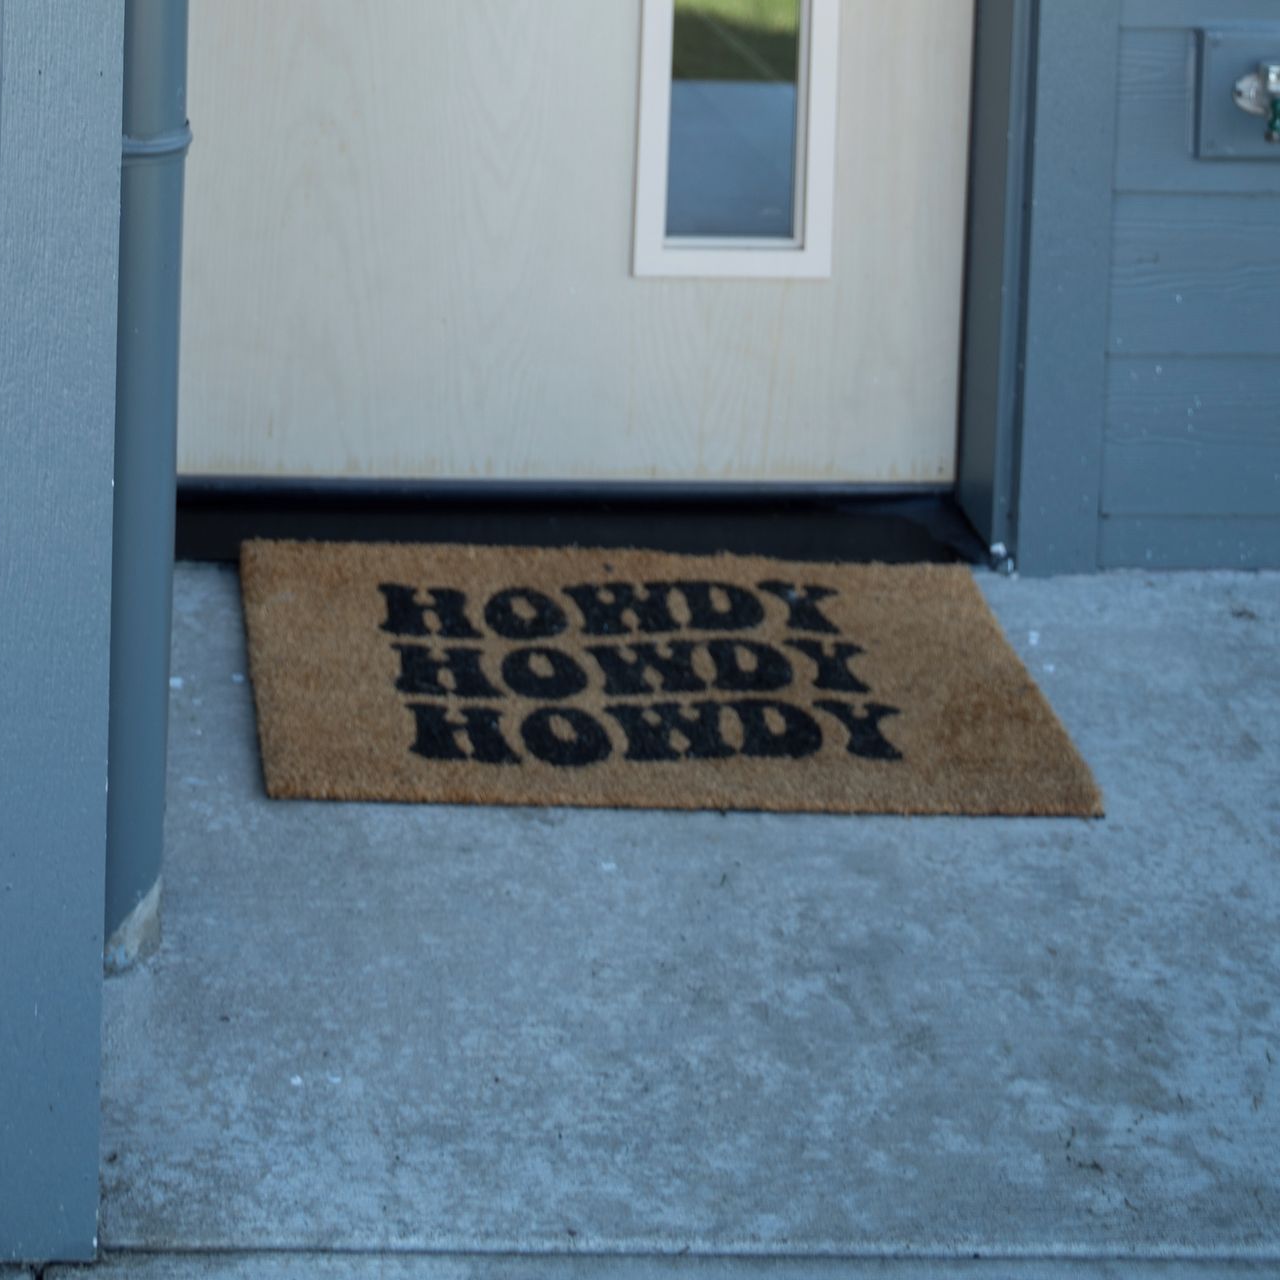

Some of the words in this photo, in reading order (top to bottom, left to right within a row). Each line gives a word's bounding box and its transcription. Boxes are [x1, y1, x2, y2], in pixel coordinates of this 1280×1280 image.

[376, 577, 843, 642] HOWDY
[390, 637, 873, 701] HOWDY
[405, 696, 906, 768] HOWDY
